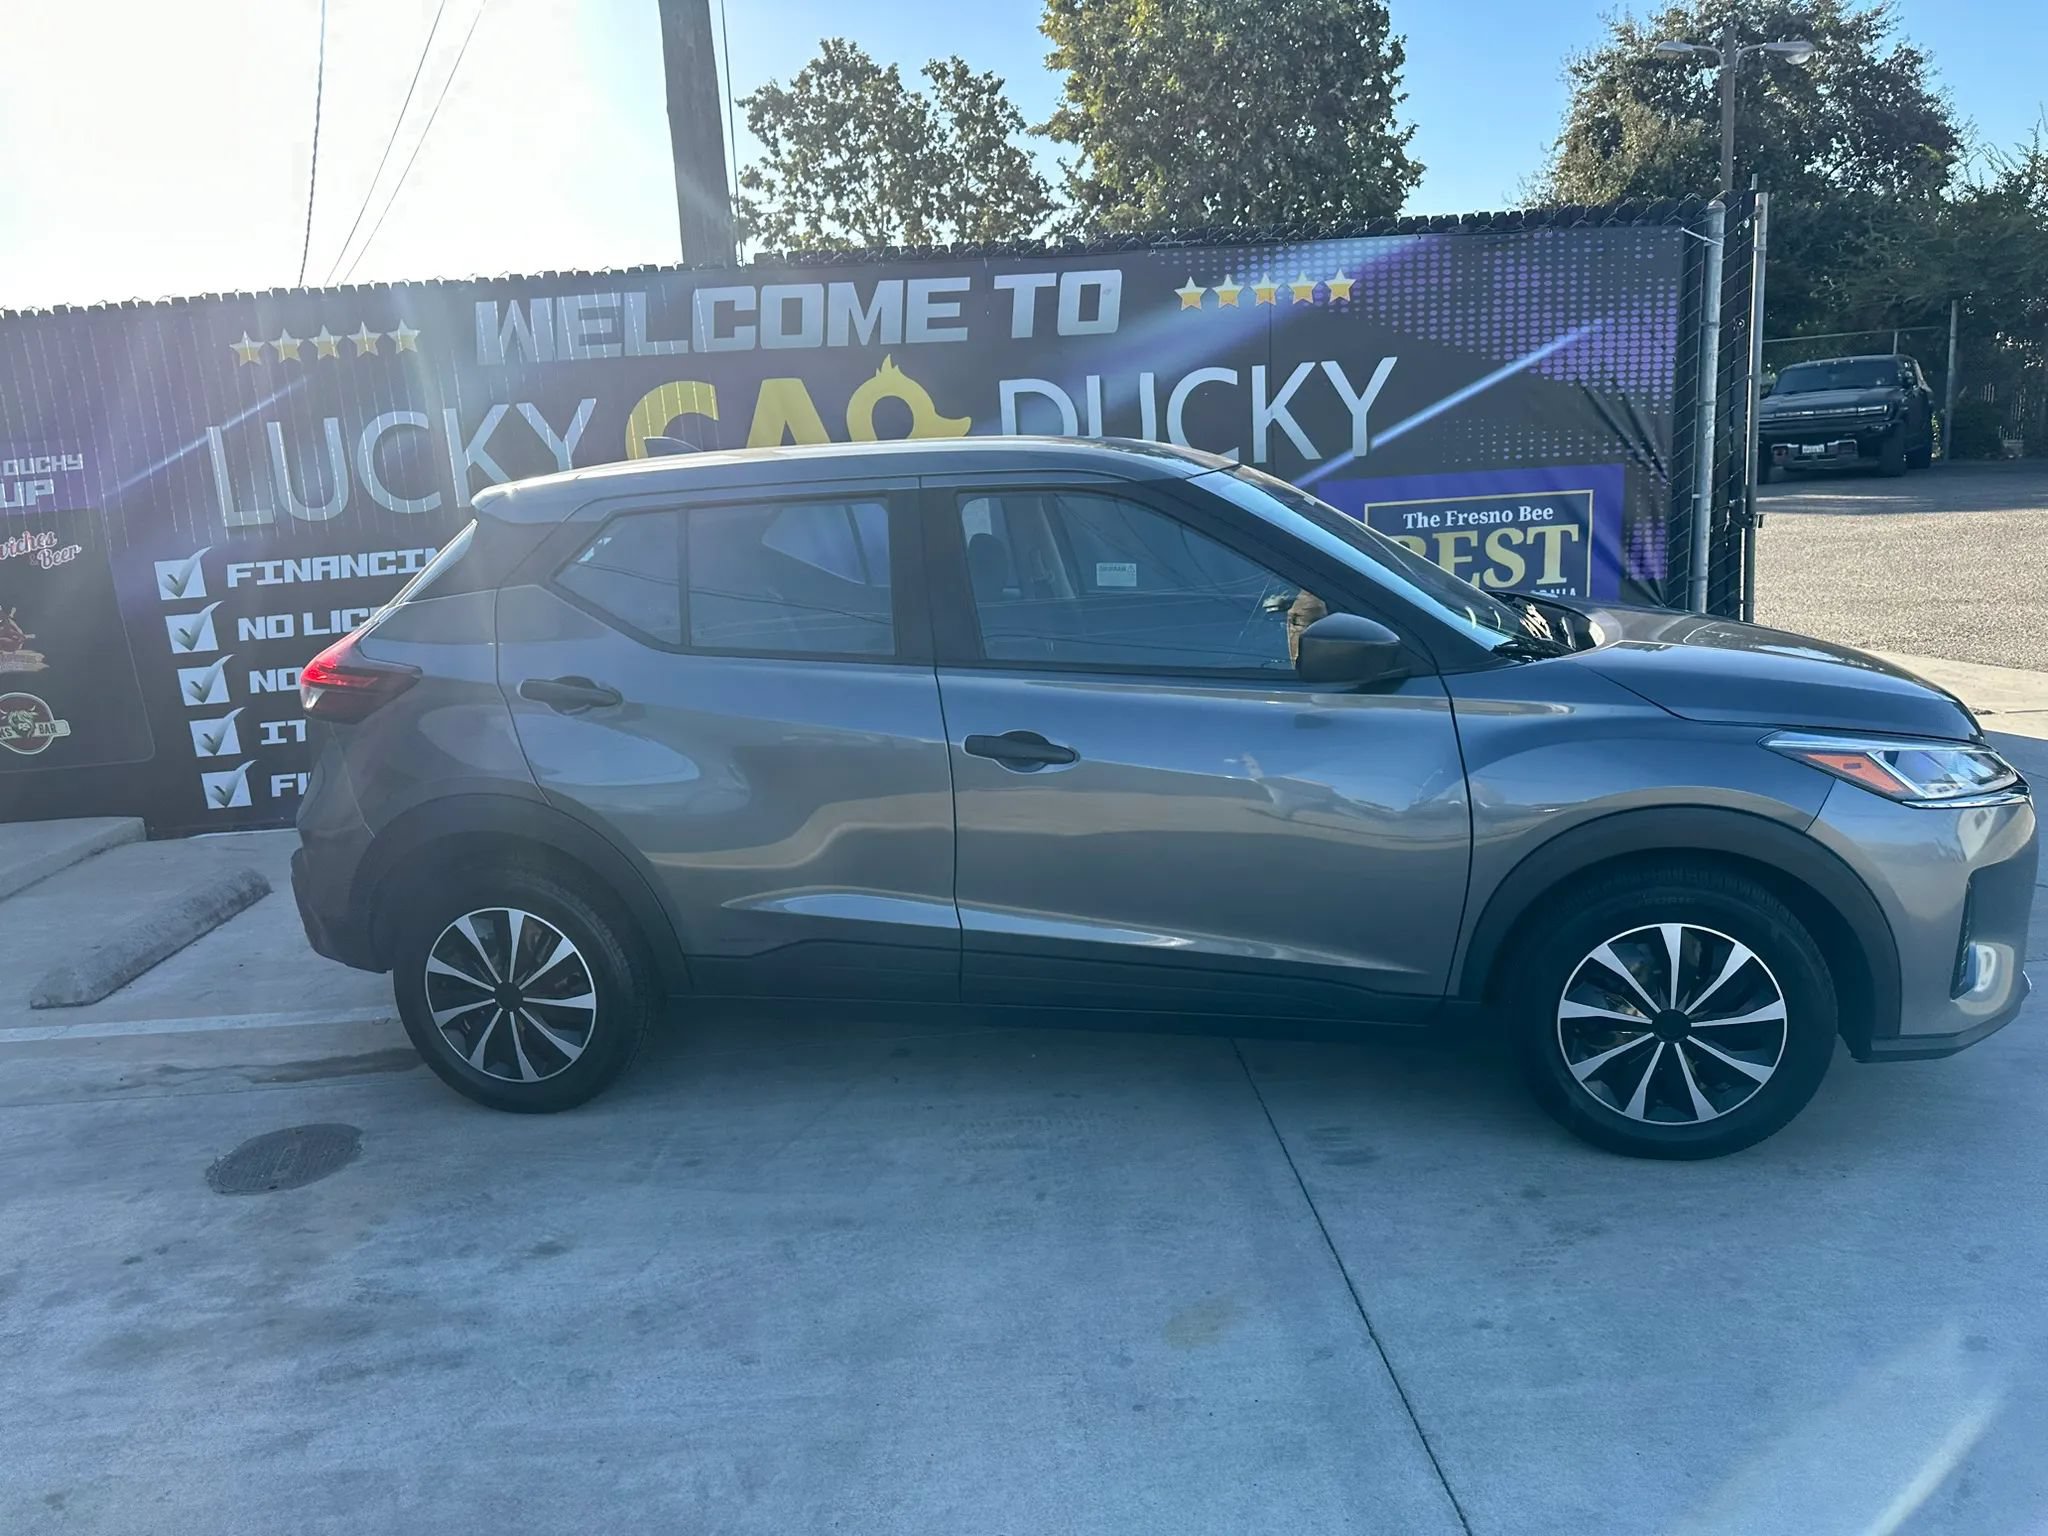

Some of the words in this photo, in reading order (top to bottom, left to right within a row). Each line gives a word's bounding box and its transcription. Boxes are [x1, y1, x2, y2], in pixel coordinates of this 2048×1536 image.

[475, 276, 971, 365] WELCOME
[993, 269, 1123, 339] TO
[206, 398, 597, 528] LUCKY
[999, 356, 1398, 464] DUCKY
[1403, 512, 1441, 530] The
[1445, 508, 1513, 527] Fresno
[1518, 505, 1554, 522] Bee
[37, 544, 82, 569] Beer
[238, 614, 294, 642] NO
[303, 606, 383, 636] LIC
[249, 667, 304, 694] NO
[38, 723, 57, 735] BAR
